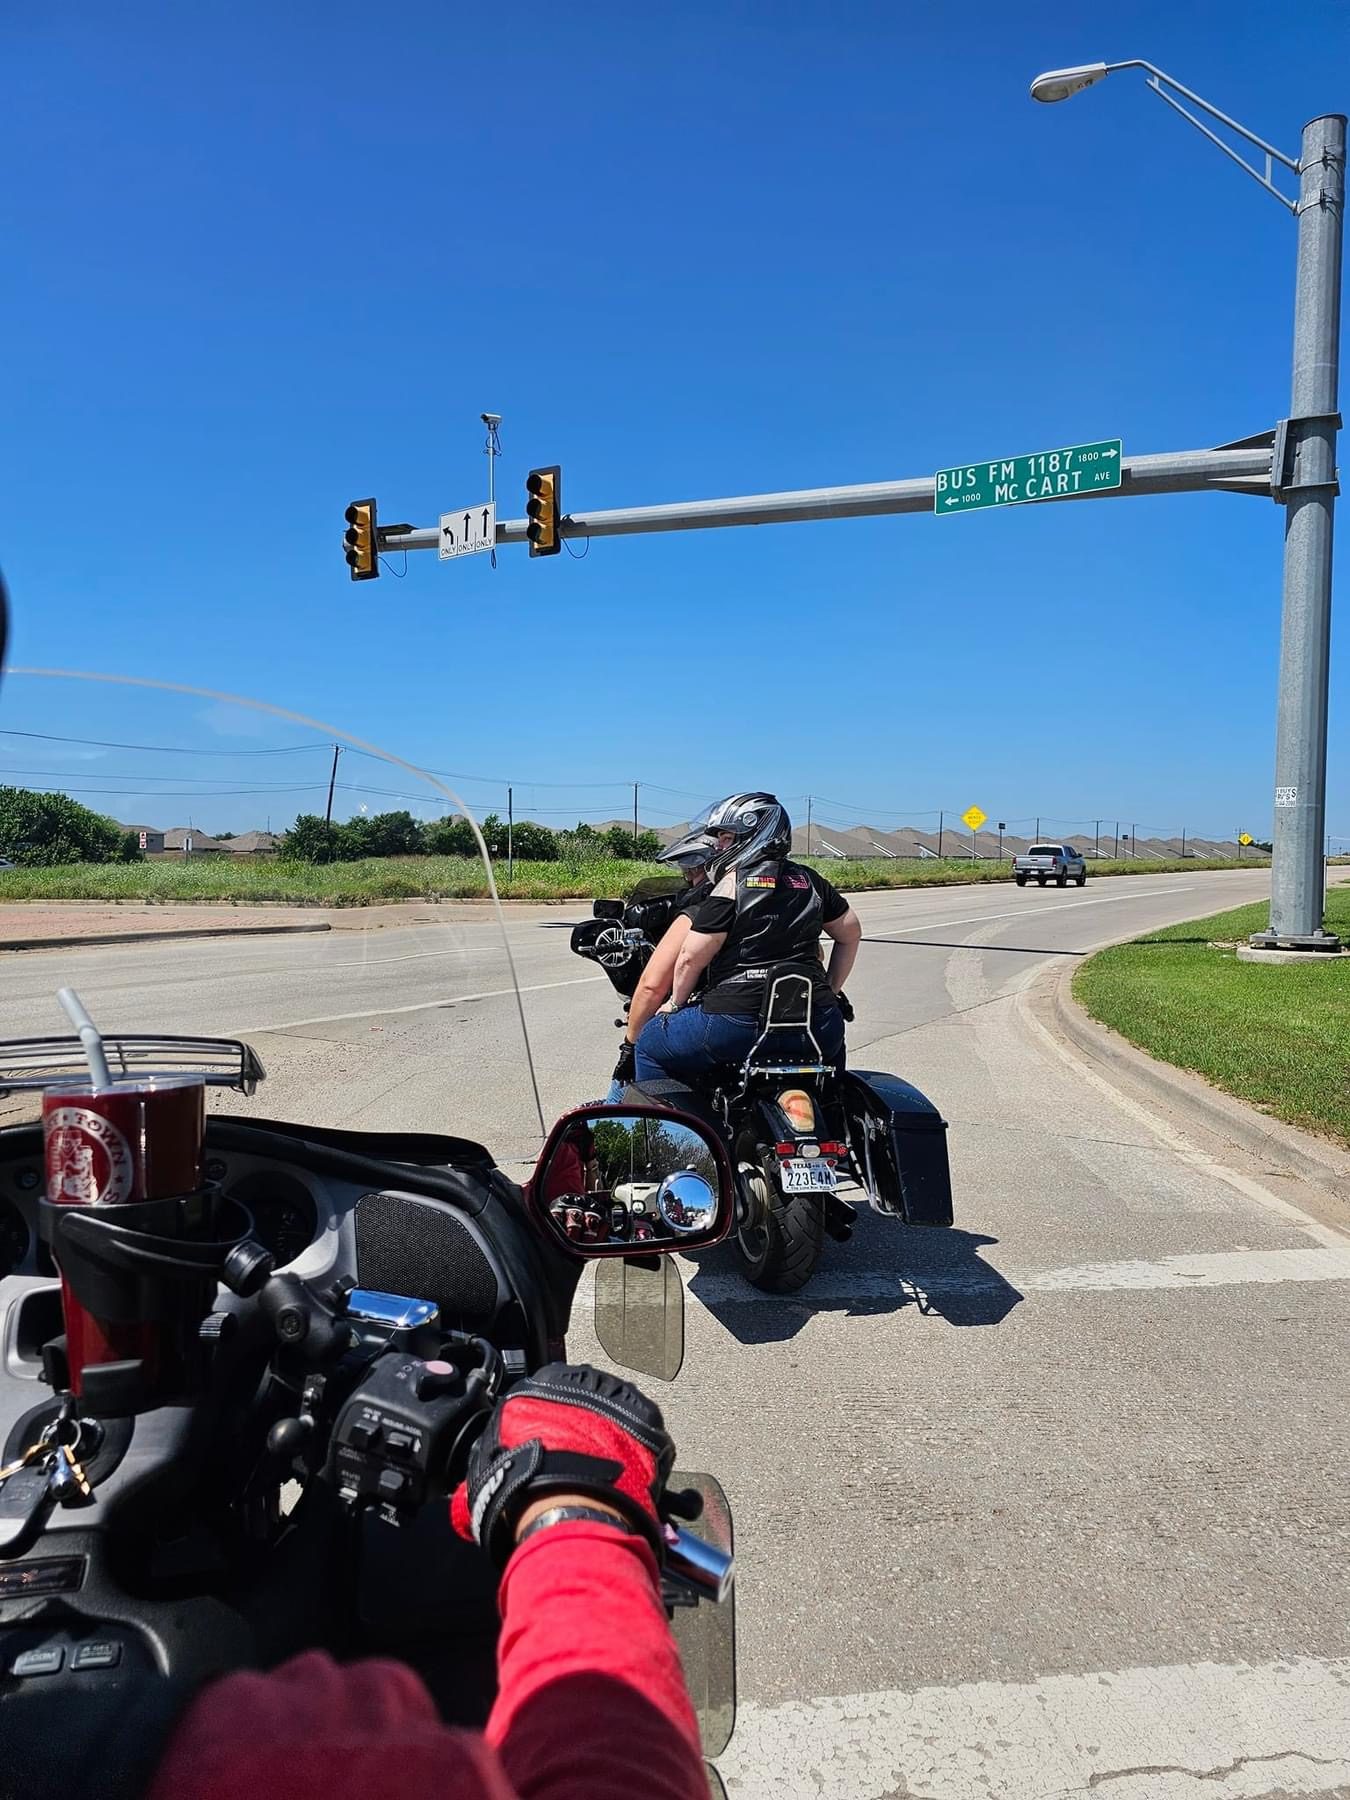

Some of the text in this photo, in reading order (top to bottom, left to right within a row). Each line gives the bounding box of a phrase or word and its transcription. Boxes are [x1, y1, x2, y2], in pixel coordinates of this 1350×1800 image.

[937, 451, 1099, 492] BUS FM 1187 1800
[962, 493, 981, 503] 1000
[1025, 471, 1082, 497] CART
[1094, 471, 1110, 482] AVE
[441, 538, 492, 556] ONLY ONLY ONLY
